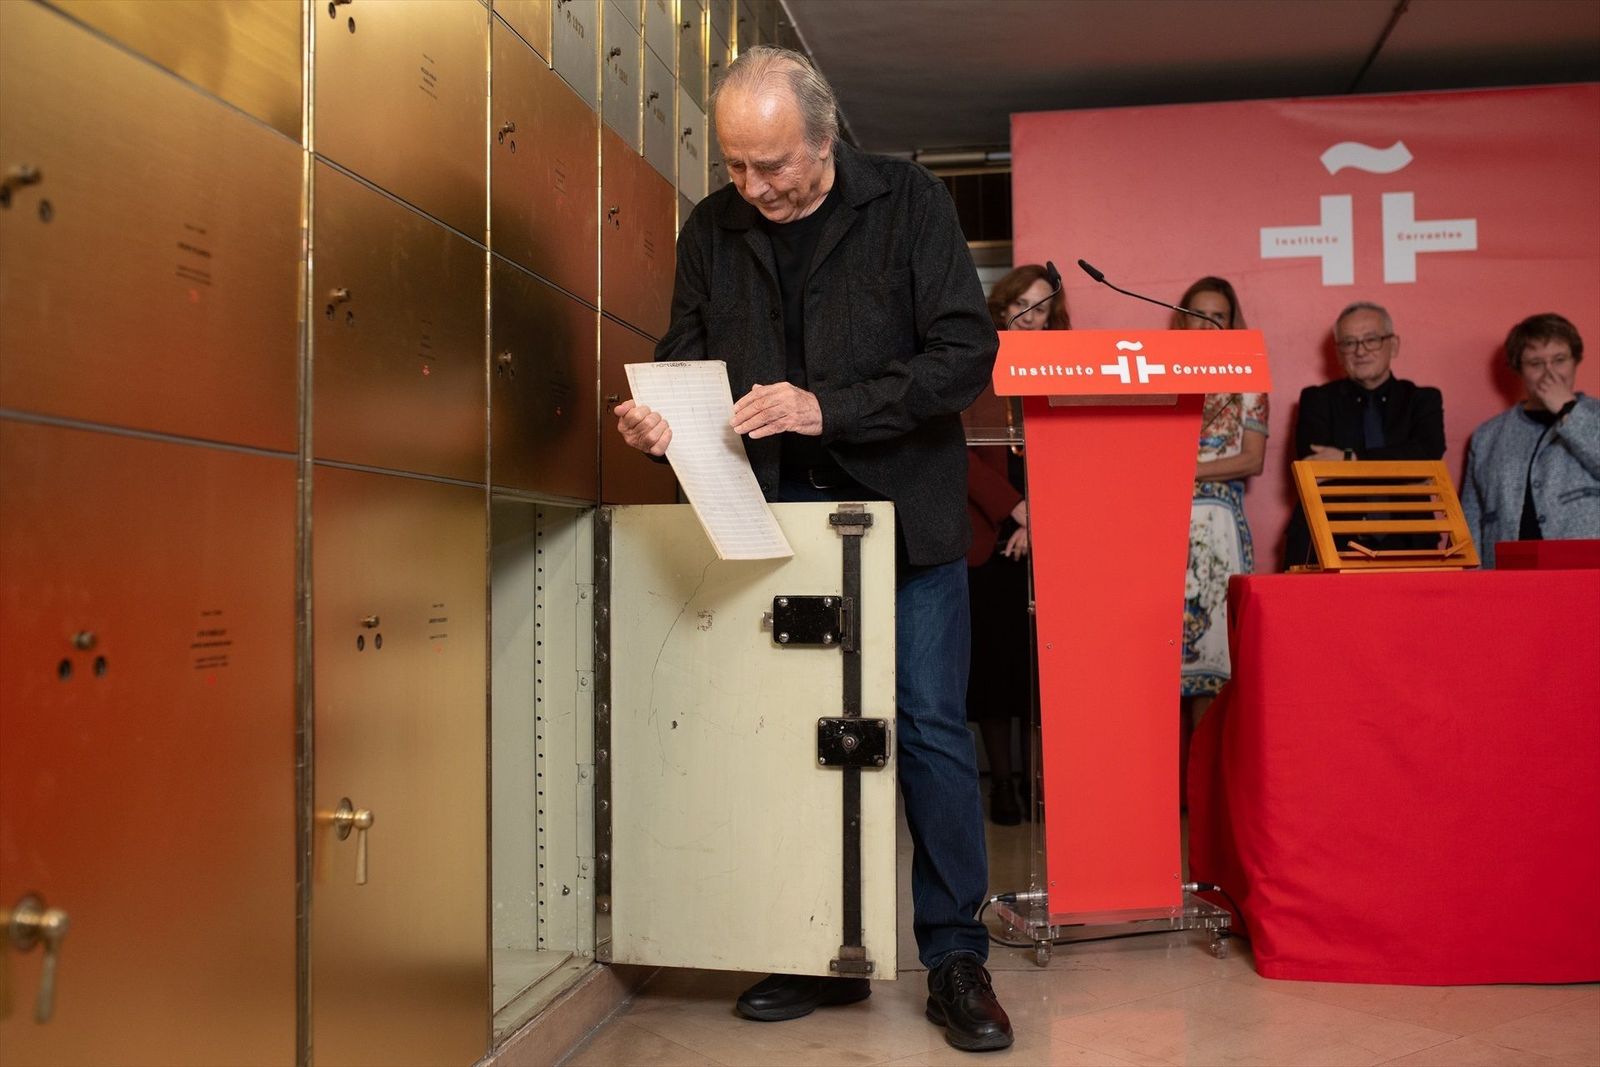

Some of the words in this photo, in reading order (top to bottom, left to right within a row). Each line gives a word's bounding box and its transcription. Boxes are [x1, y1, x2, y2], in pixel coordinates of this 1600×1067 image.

[1275, 236, 1339, 246] Instituto
[1397, 231, 1463, 241] Cervantes
[1010, 365, 1094, 376] Instituto
[1172, 363, 1253, 375] Cervantes
